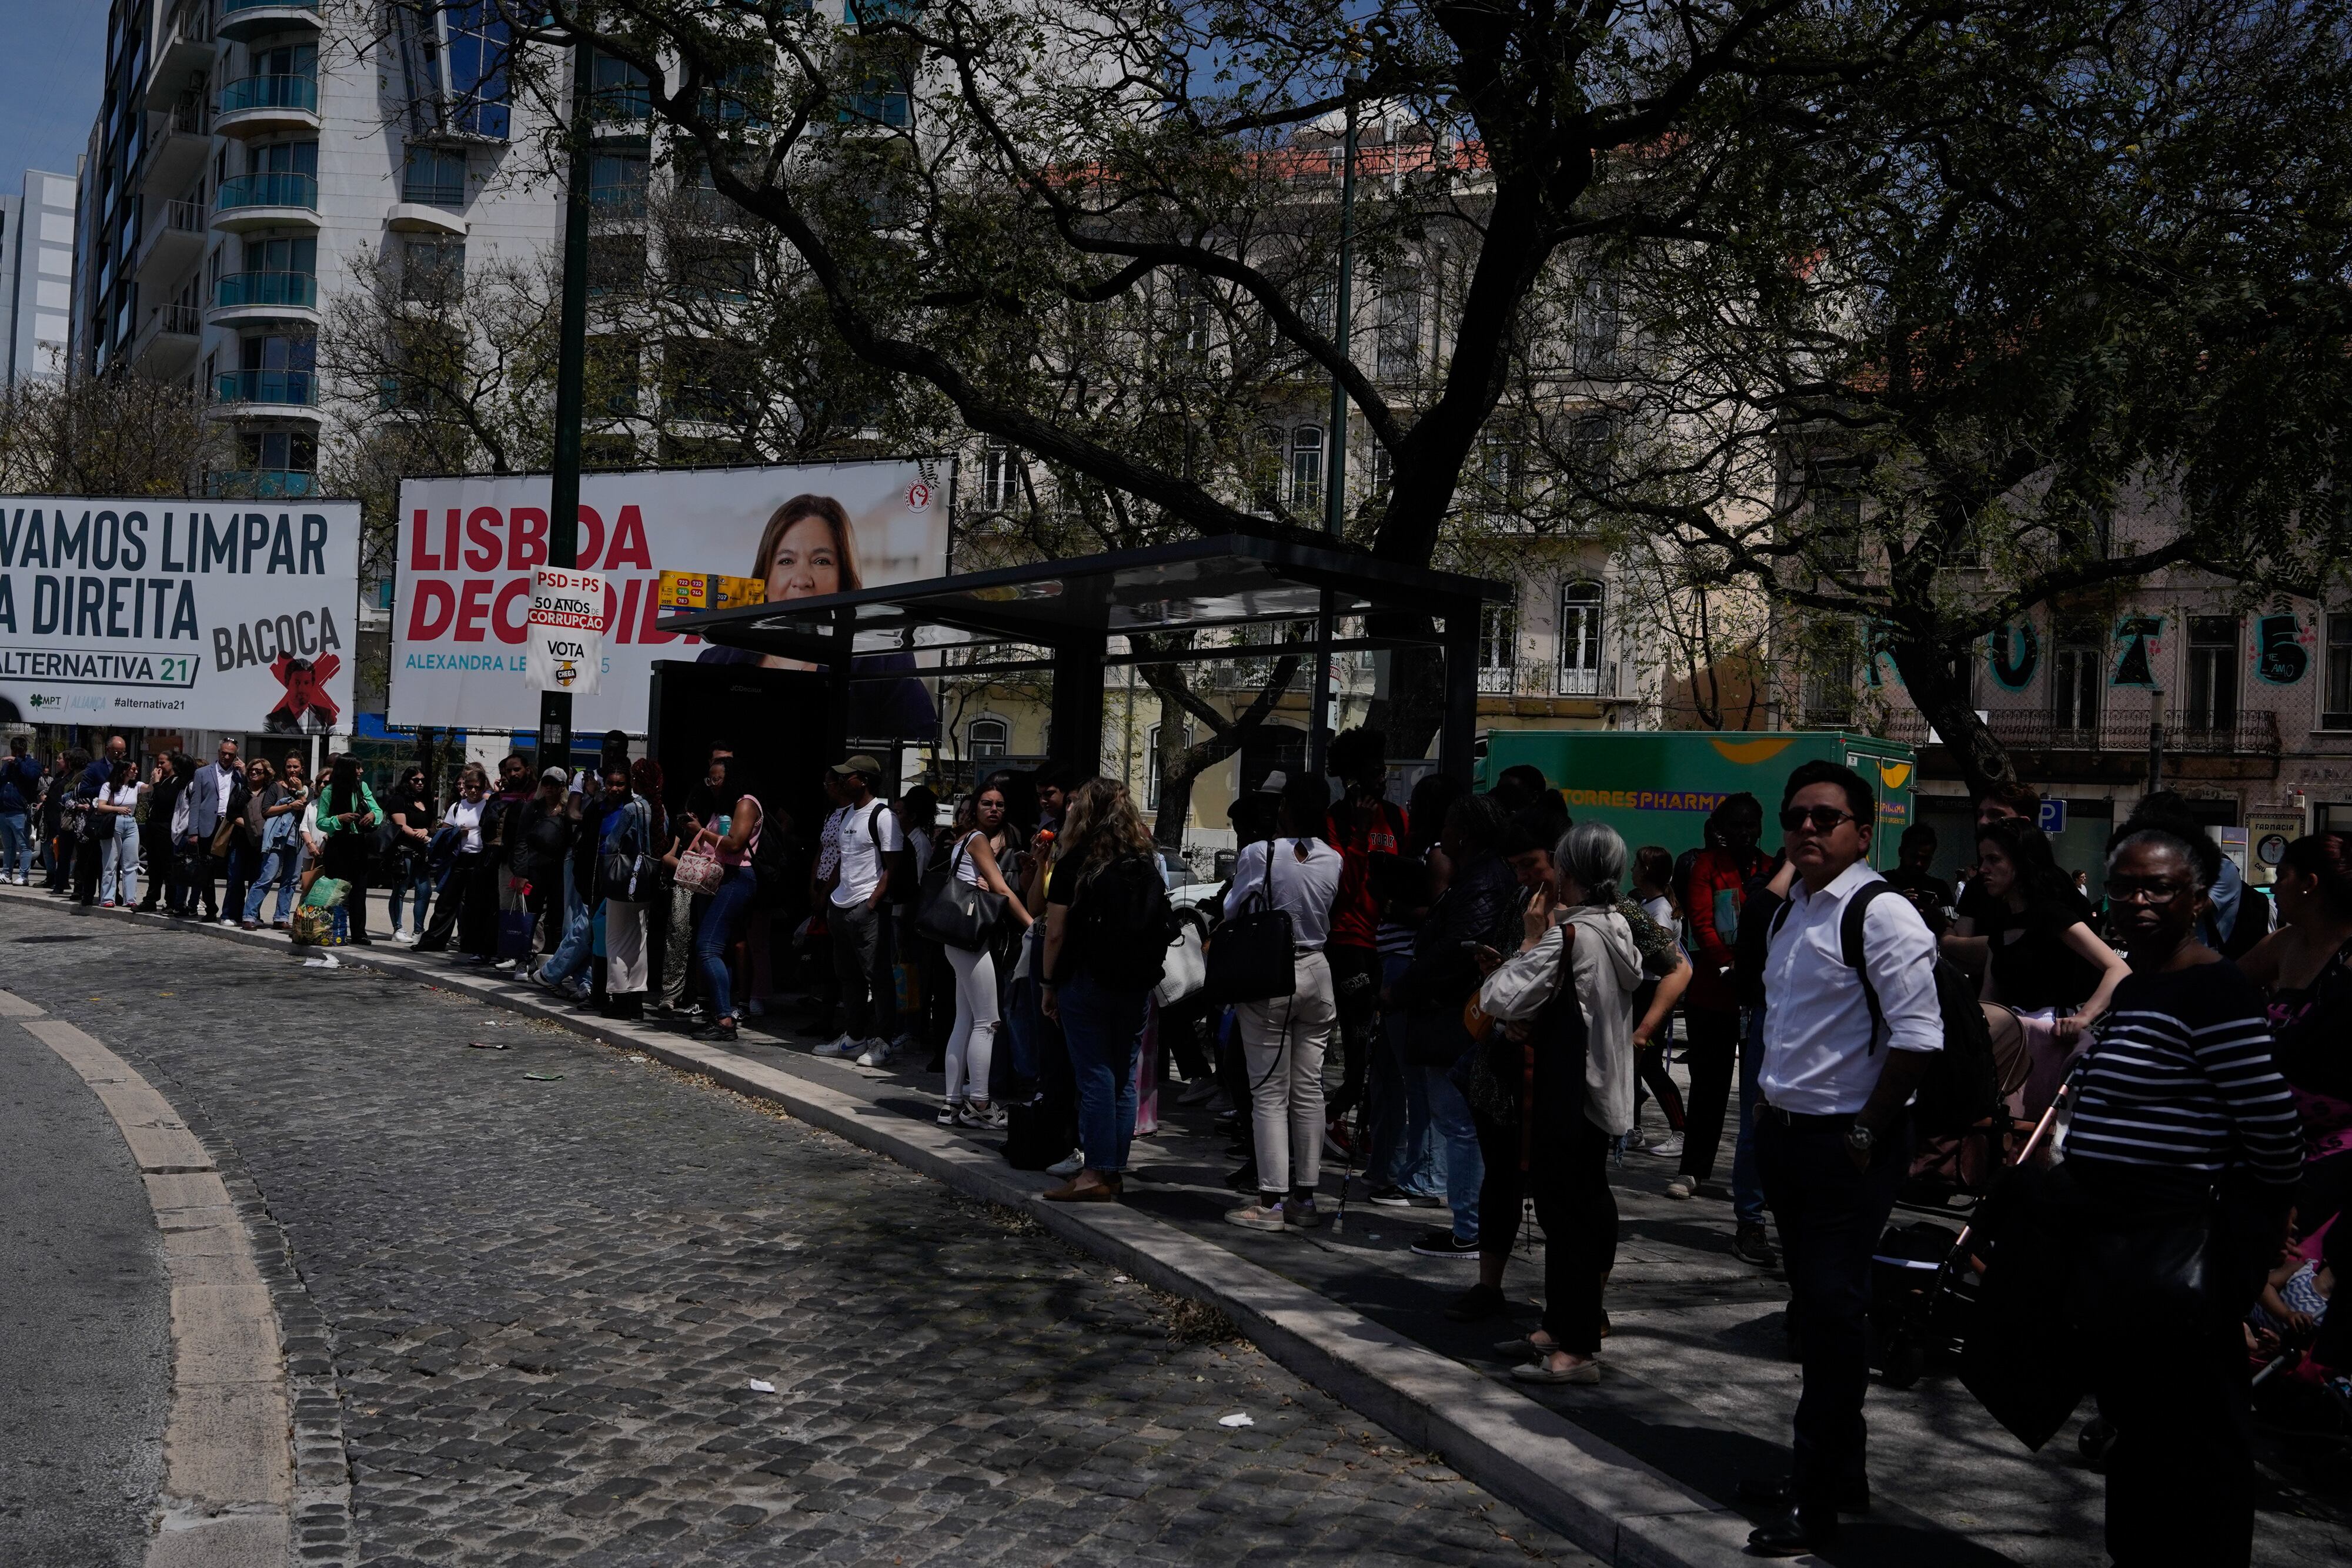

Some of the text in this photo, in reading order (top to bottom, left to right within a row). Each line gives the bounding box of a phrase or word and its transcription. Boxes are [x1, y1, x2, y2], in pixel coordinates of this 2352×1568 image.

[0, 509, 328, 575] VAMOS LIMPAR
[537, 571, 568, 589] PSD
[582, 577, 599, 593] PS
[32, 574, 199, 640] DIREITA
[534, 597, 552, 609] 50
[554, 598, 590, 614] ANOS
[529, 609, 603, 629] CORRUPÇÃO
[213, 607, 342, 673] BACOCA
[547, 640, 584, 657] VOTA
[0, 651, 187, 681] LTERNATIVA 21
[406, 653, 504, 671] ALEXANDRA
[558, 670, 575, 678] CHEGA
[730, 684, 763, 694] JCDecaux
[42, 696, 61, 705] MPT
[114, 697, 185, 710] #alternativa21
[2038, 803, 2056, 828] P
[1370, 833, 1395, 848] YORK
